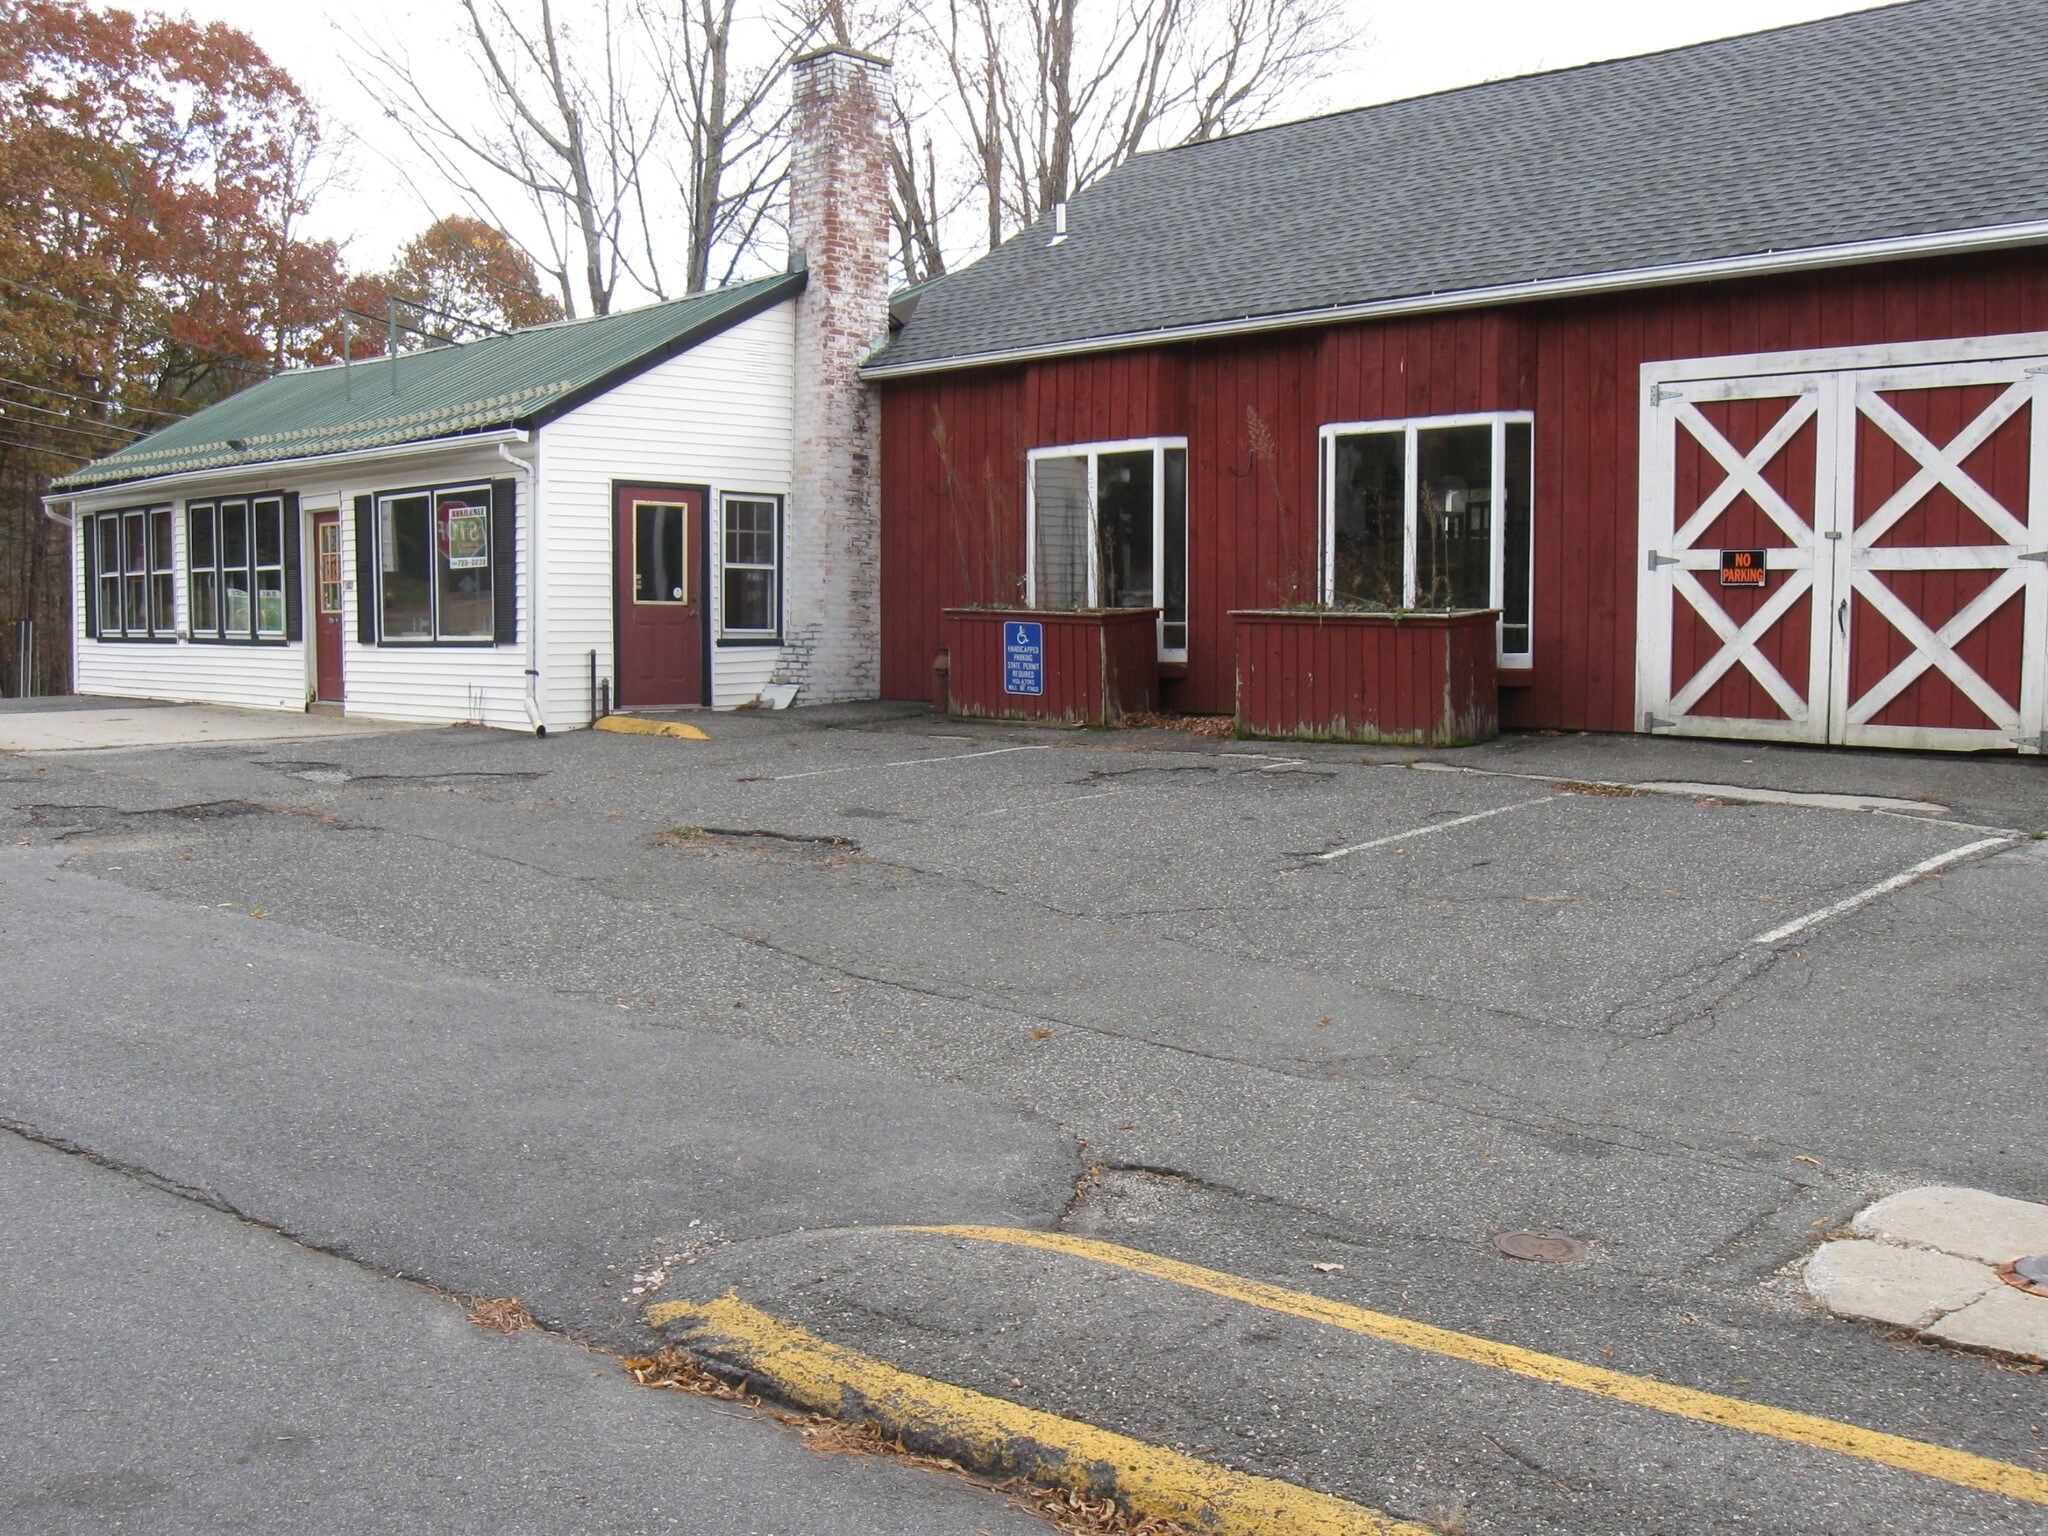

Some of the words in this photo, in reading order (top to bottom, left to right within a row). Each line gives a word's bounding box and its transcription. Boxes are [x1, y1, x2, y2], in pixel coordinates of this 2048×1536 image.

[1735, 553, 1751, 567] NO
[1723, 568, 1763, 582] PARKING
[1007, 645, 1039, 654] HANDICAPPED
[1014, 654, 1033, 662] PARKING
[1007, 661, 1021, 669] STATE
[1023, 662, 1040, 670] PERMIT
[1012, 670, 1035, 678] REQUIRED
